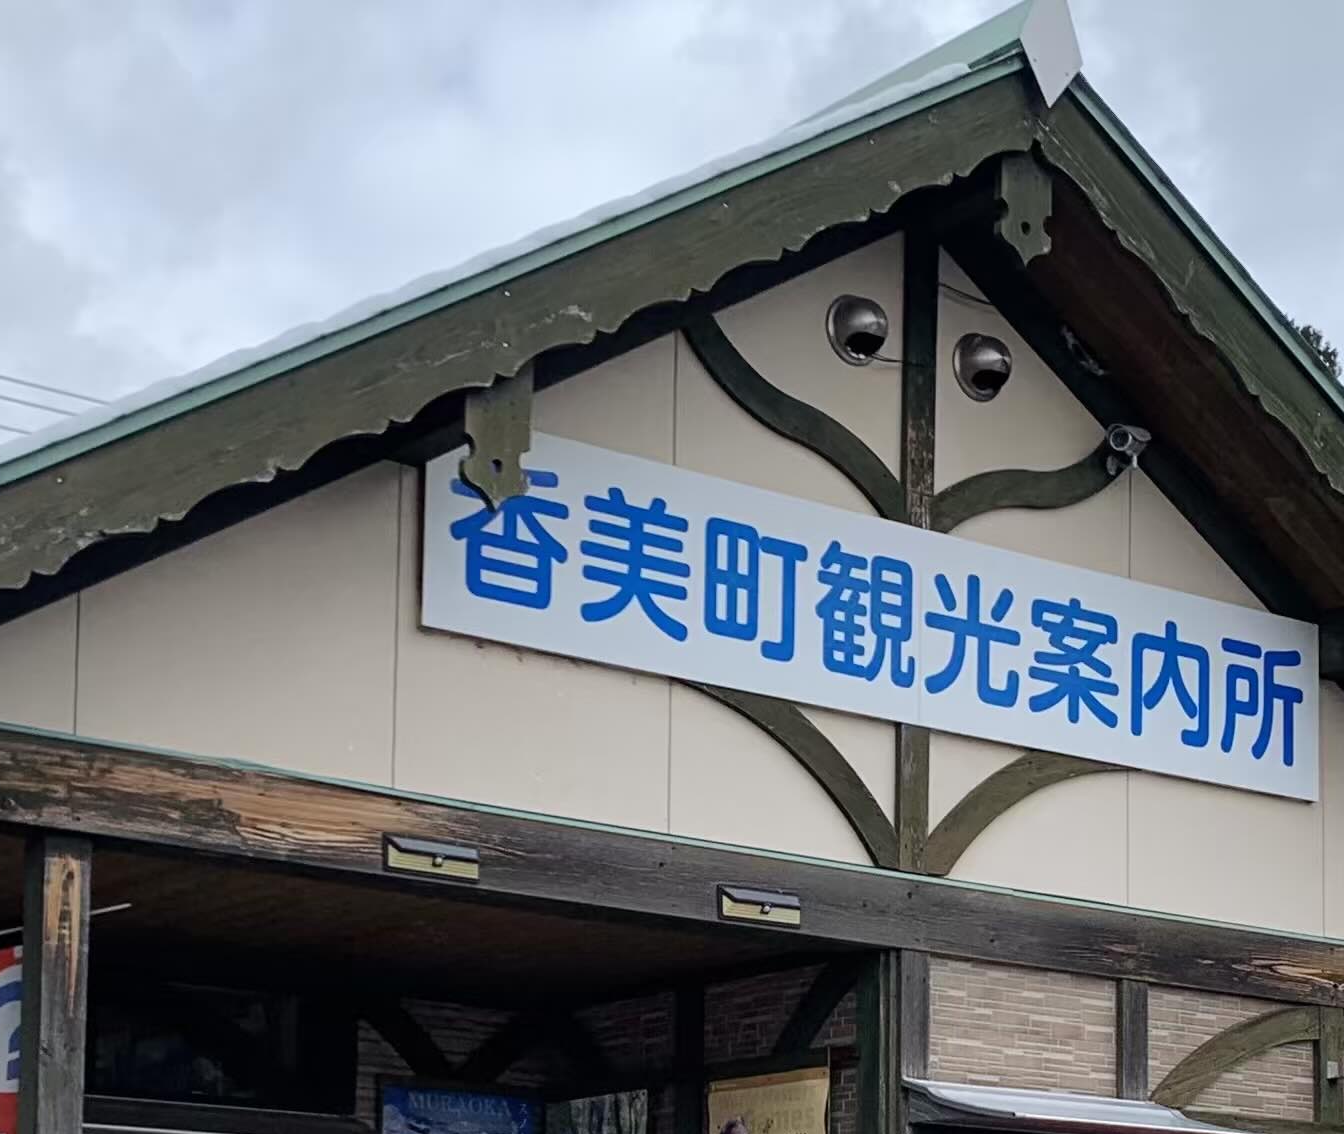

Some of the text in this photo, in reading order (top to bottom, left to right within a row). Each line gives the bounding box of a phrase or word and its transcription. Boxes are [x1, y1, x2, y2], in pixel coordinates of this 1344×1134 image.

[450, 471, 1304, 766] 香美町観光案内所
